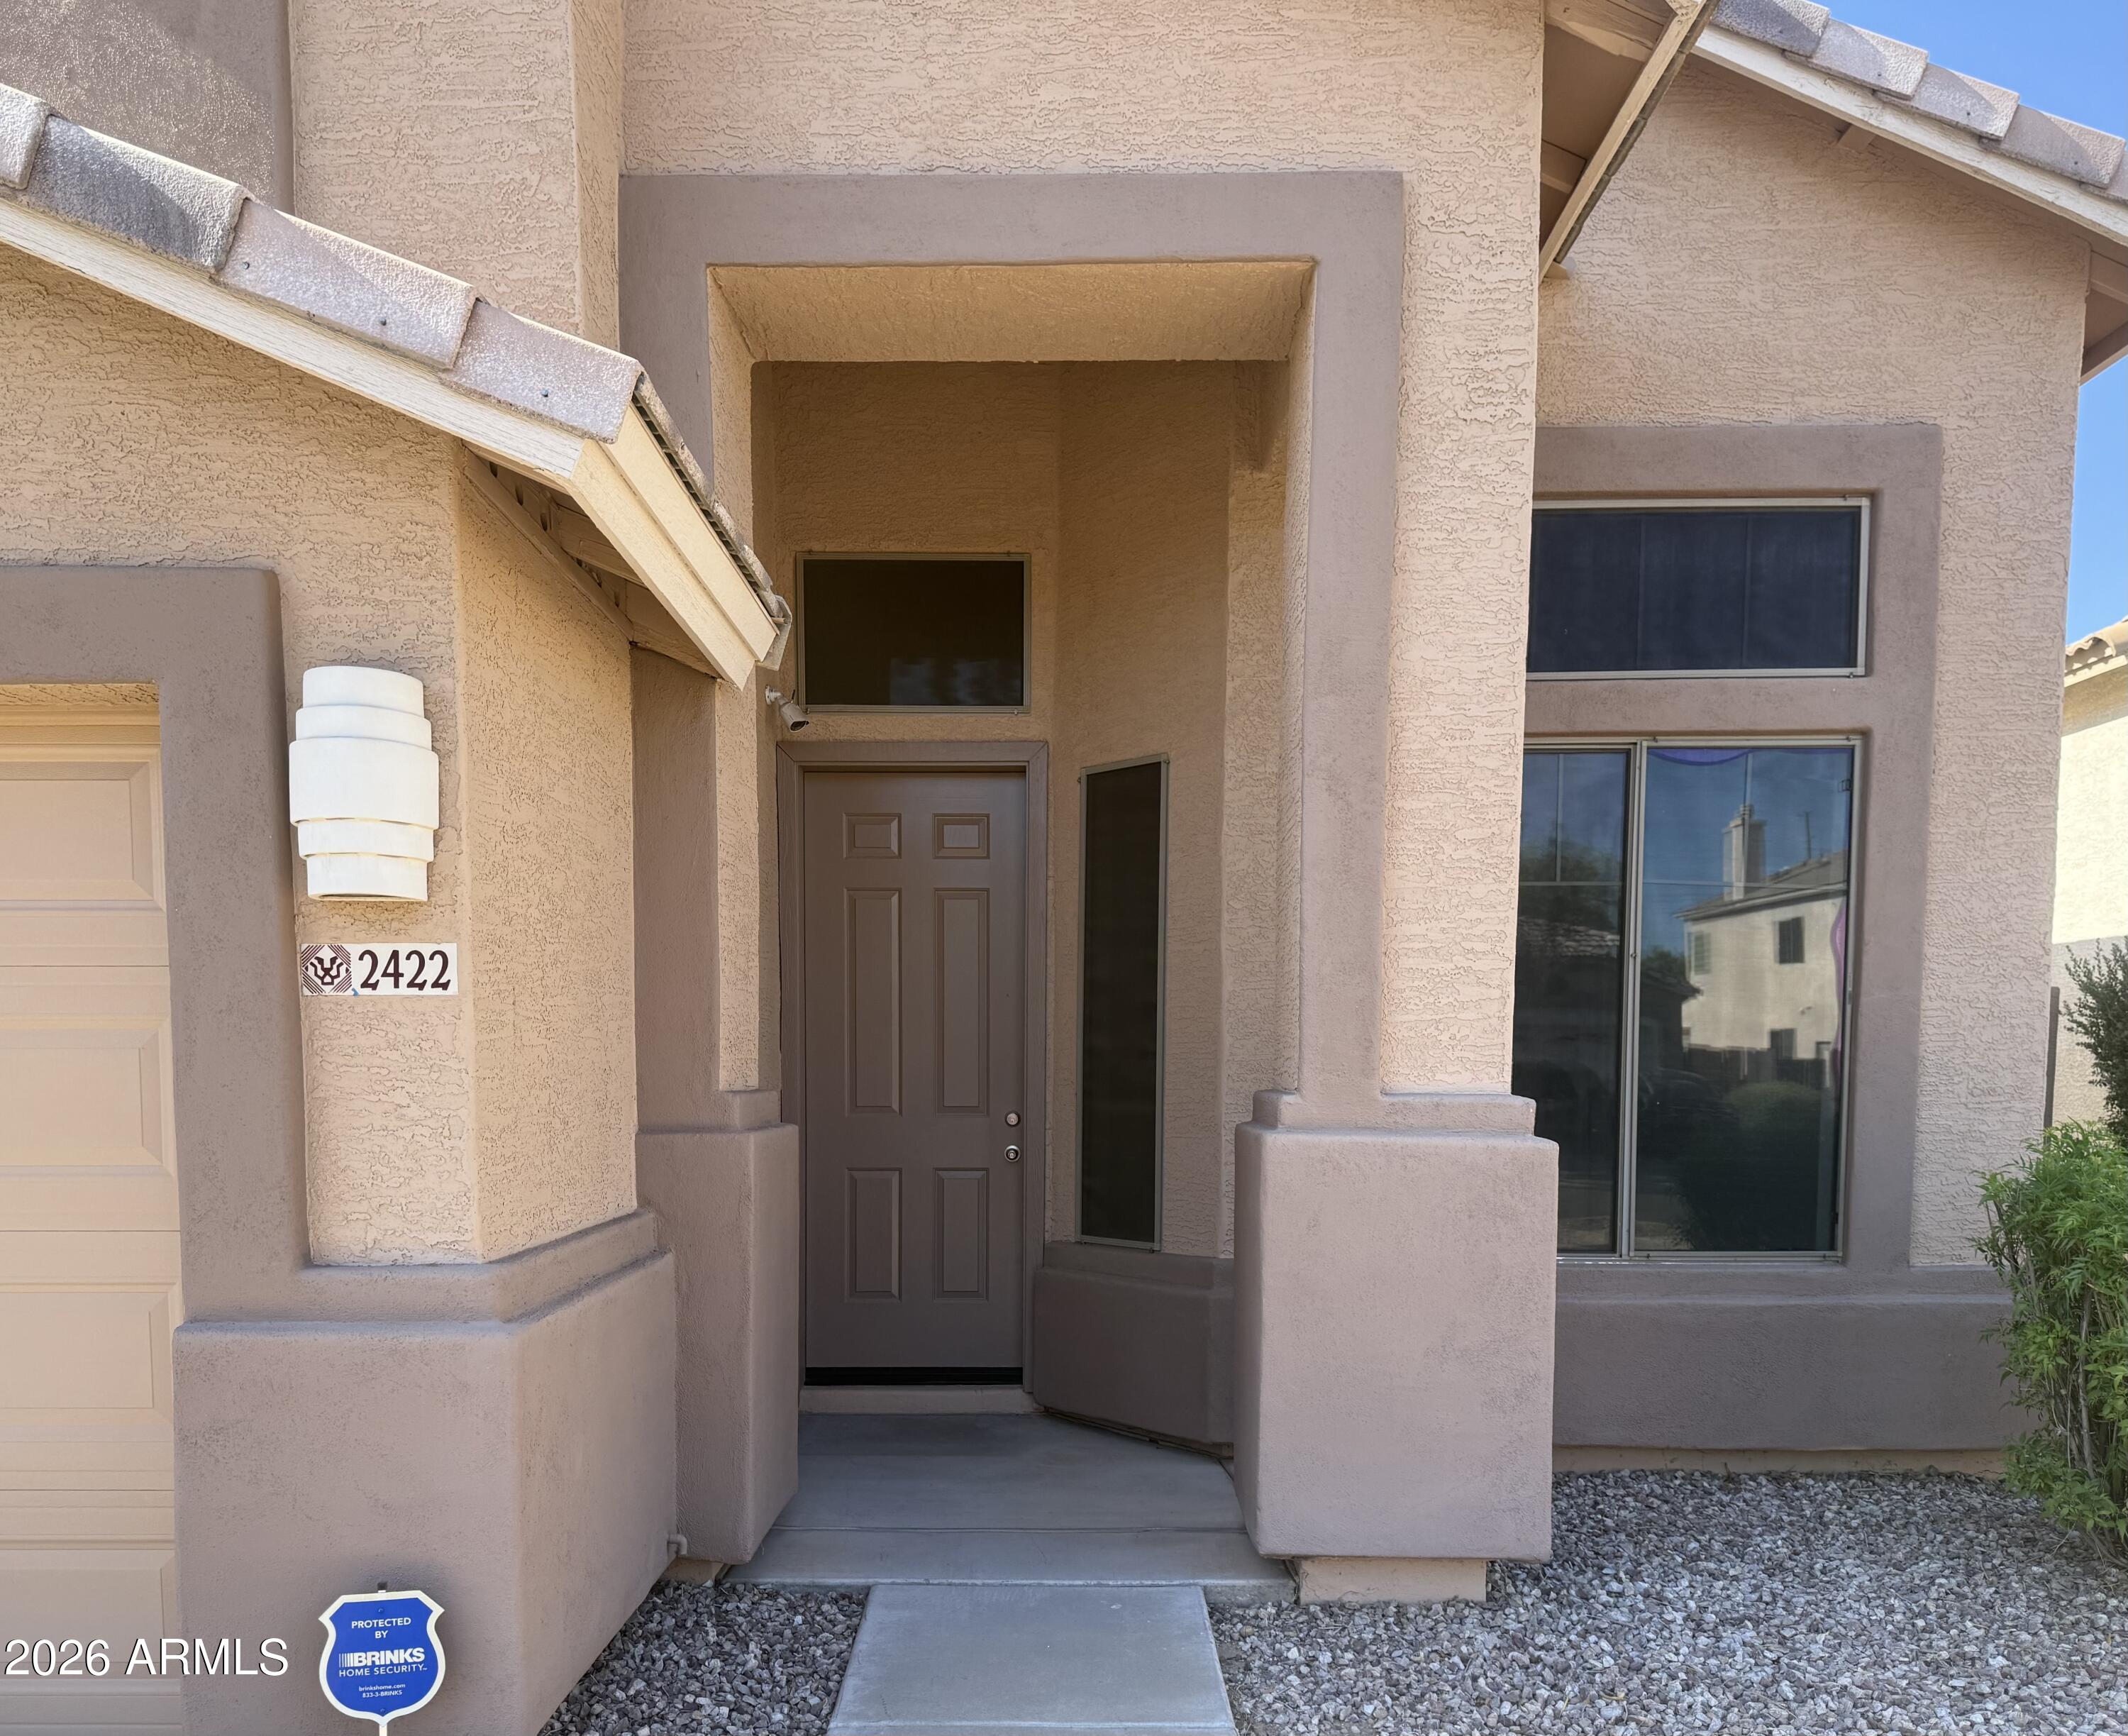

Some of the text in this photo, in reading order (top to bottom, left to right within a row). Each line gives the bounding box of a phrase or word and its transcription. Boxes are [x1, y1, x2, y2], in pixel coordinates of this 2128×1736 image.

[358, 949, 451, 991] 2422
[351, 1618, 411, 1629] PROTECTED
[375, 1630, 388, 1639] BY
[353, 1647, 426, 1667] BRINKS
[339, 1664, 425, 1677] HOME SECURITY
[362, 1690, 403, 1698] 833-3-BRINKS
